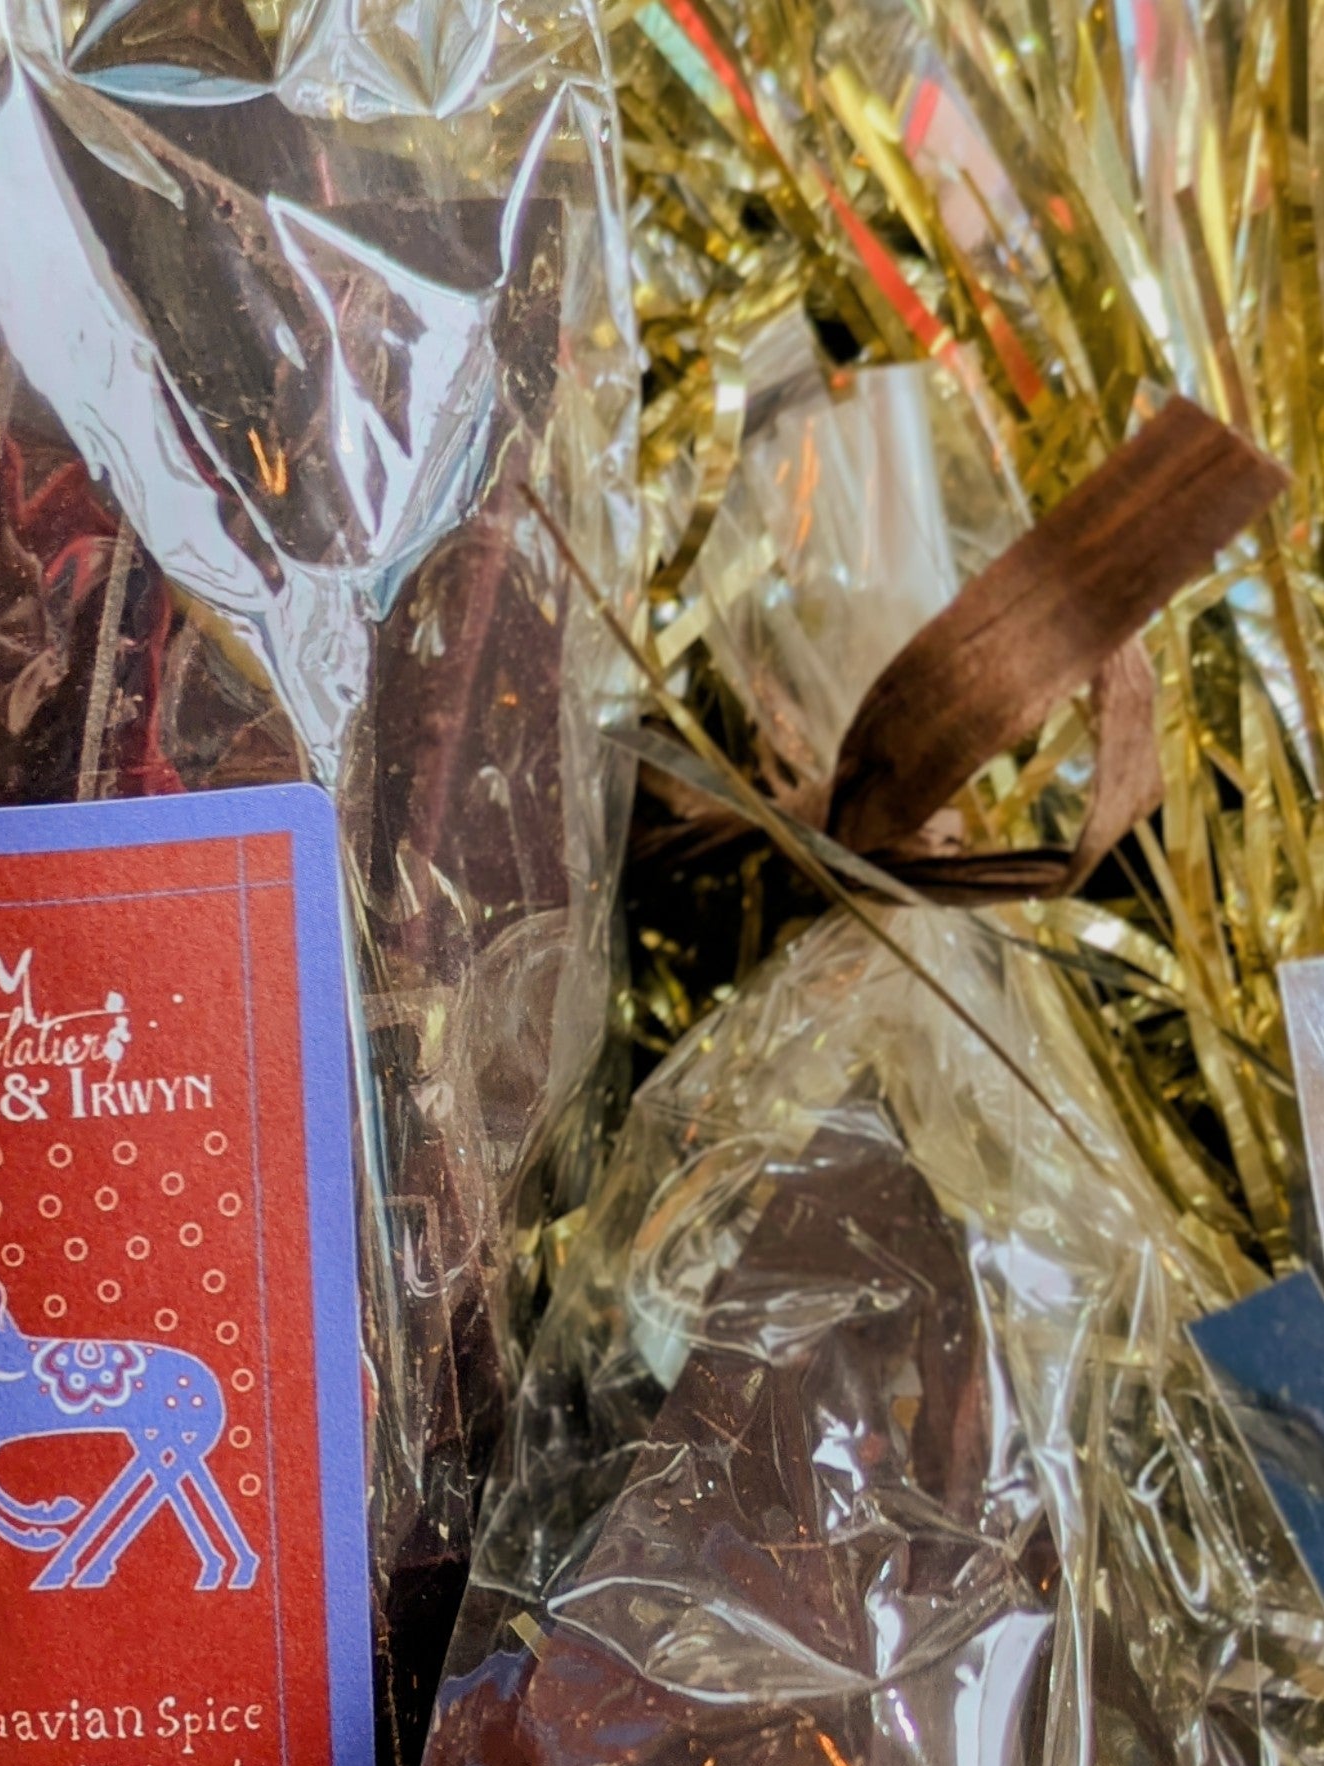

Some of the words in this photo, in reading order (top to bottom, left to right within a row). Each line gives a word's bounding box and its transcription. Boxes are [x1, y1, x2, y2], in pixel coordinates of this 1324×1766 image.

[0, 1073, 50, 1122] &
[70, 1067, 213, 1120] IRWYN
[156, 1696, 263, 1754] Spice
